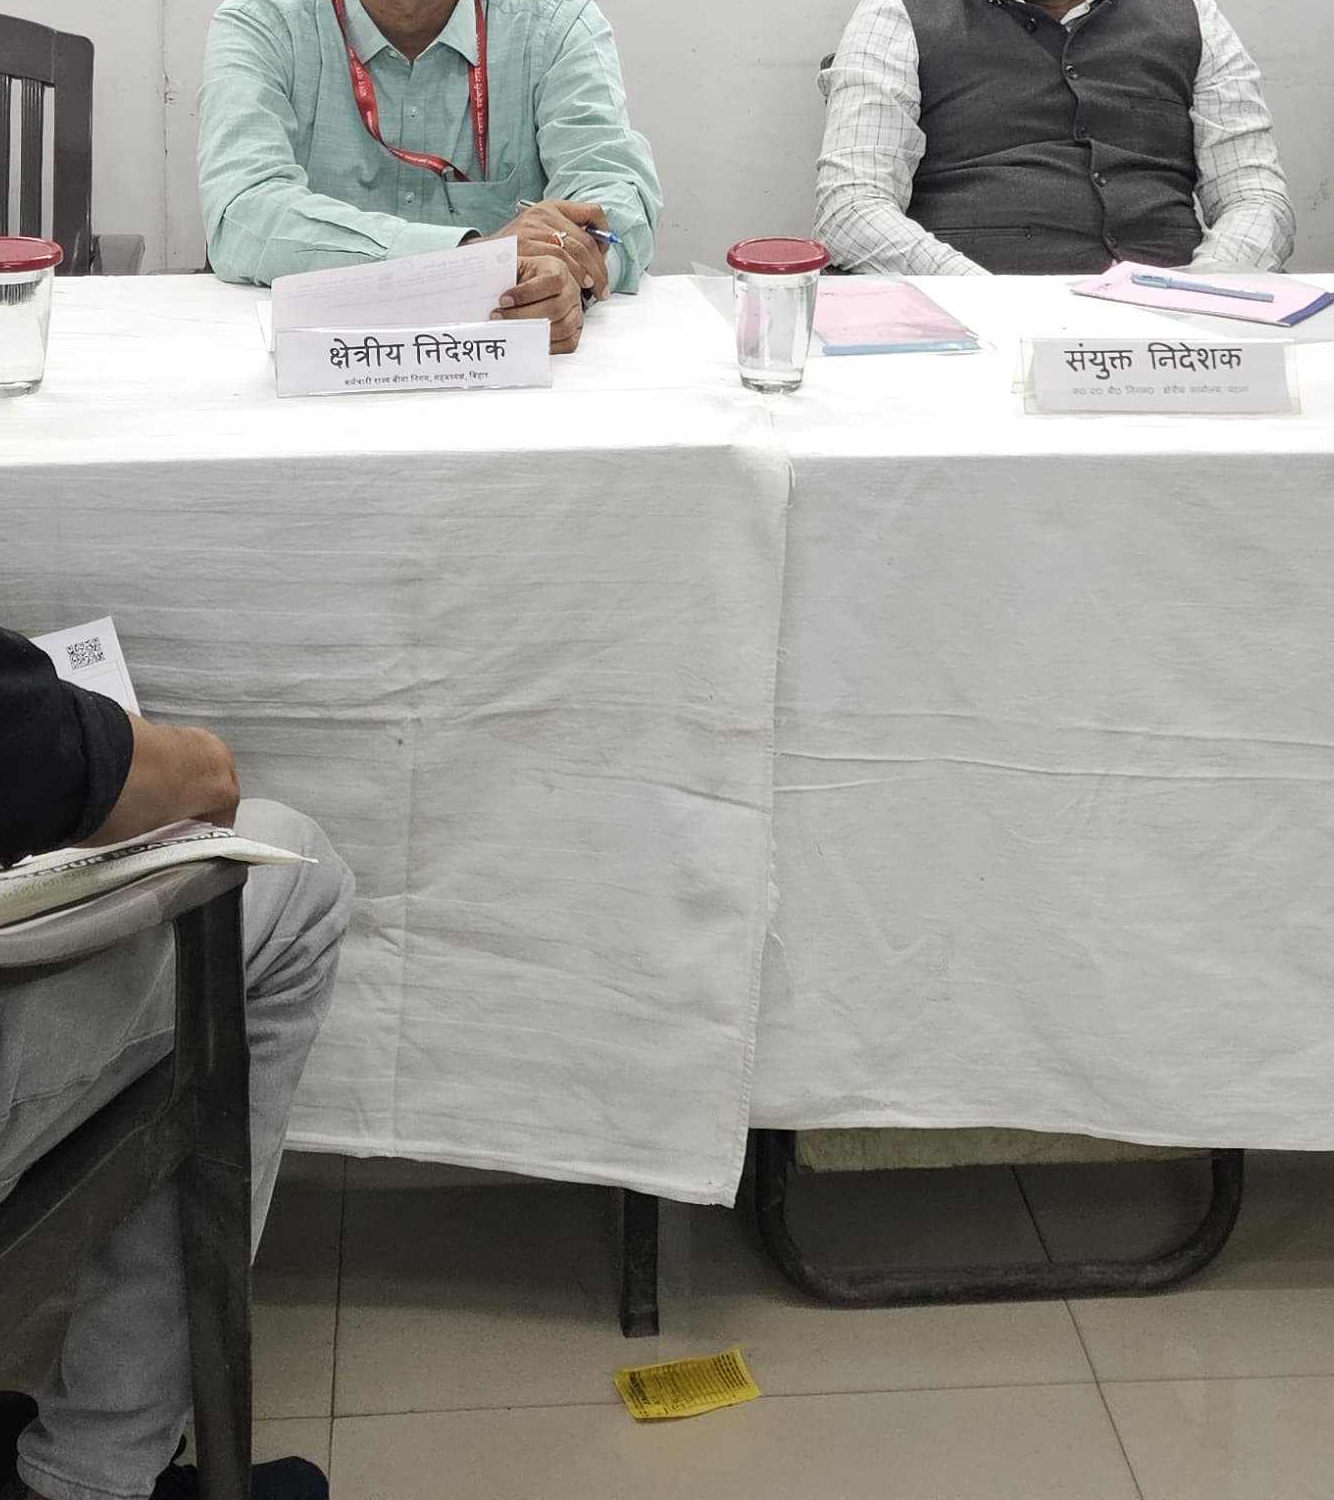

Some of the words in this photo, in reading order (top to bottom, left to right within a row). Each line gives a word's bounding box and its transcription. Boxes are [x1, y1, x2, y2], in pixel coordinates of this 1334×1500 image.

[329, 335, 405, 369] क्षेत्रीय
[412, 332, 507, 366] निदेशक
[1064, 343, 1134, 380] संयुक्त
[1147, 342, 1244, 373] निदेशक
